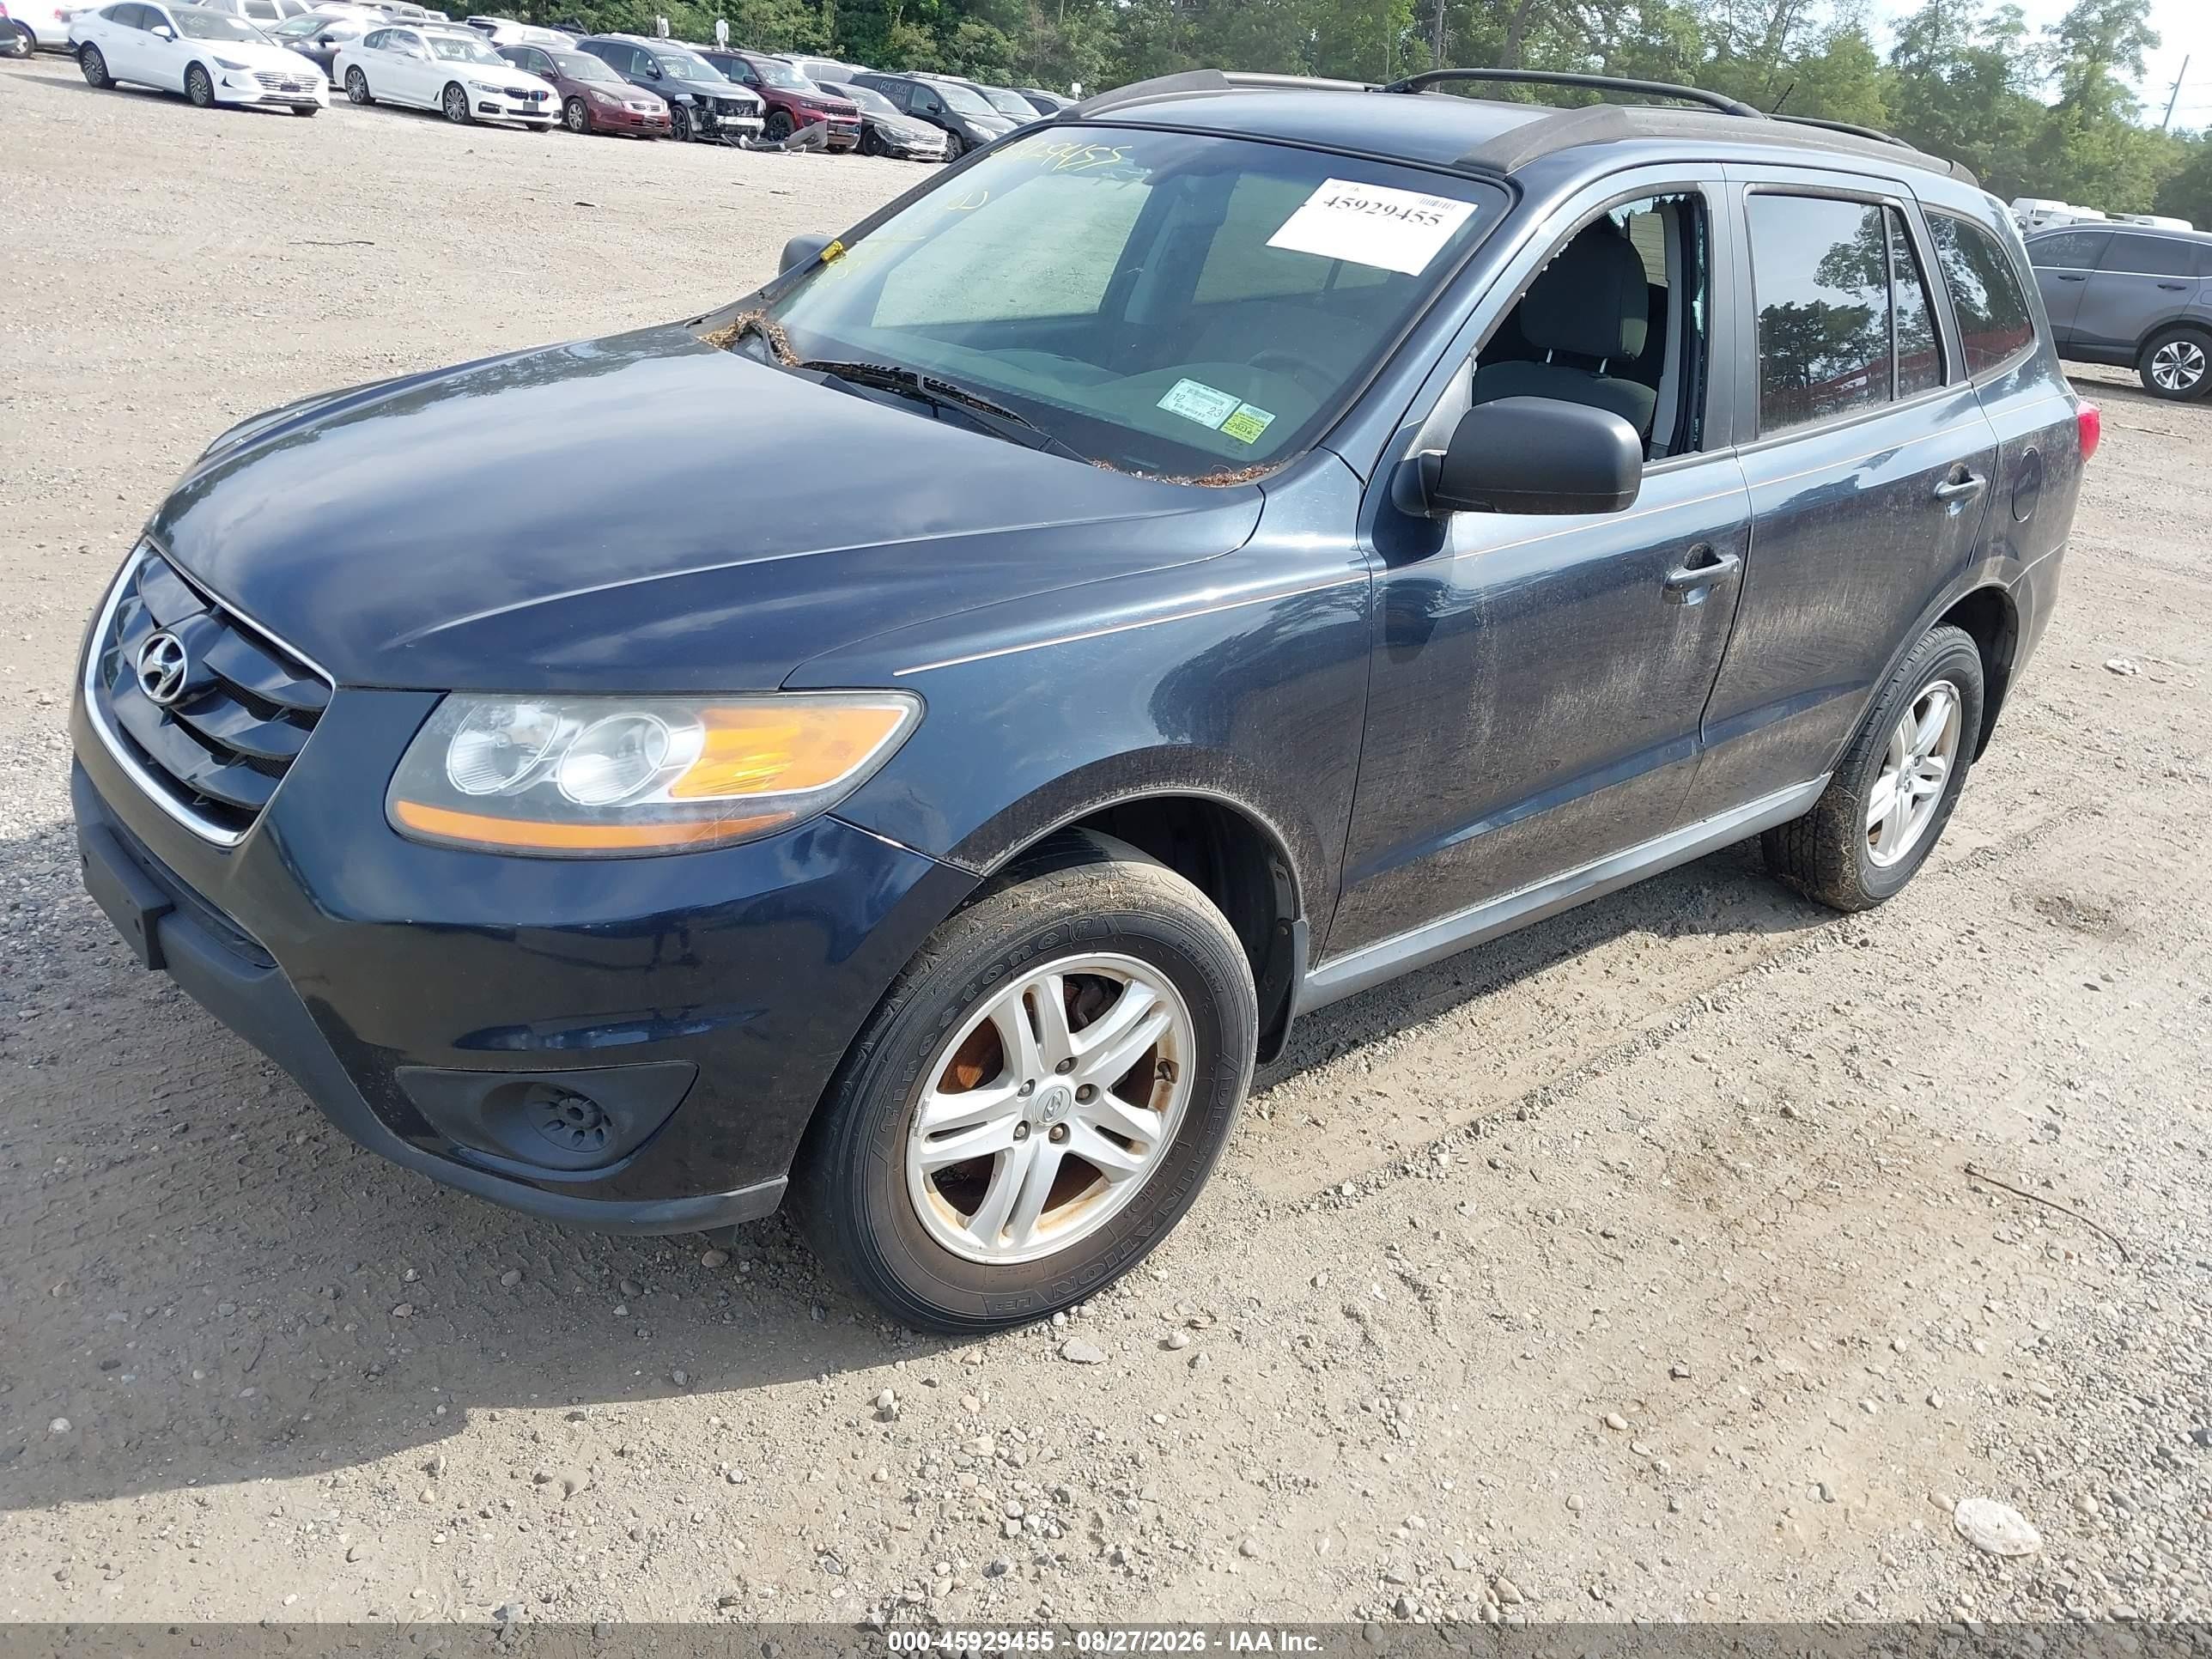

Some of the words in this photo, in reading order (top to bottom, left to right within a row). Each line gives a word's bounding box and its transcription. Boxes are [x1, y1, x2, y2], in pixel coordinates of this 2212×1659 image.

[1322, 195, 1444, 228] 45929455
[1206, 406, 1224, 418] 23
[879, 932, 1060, 1134] Firestone
